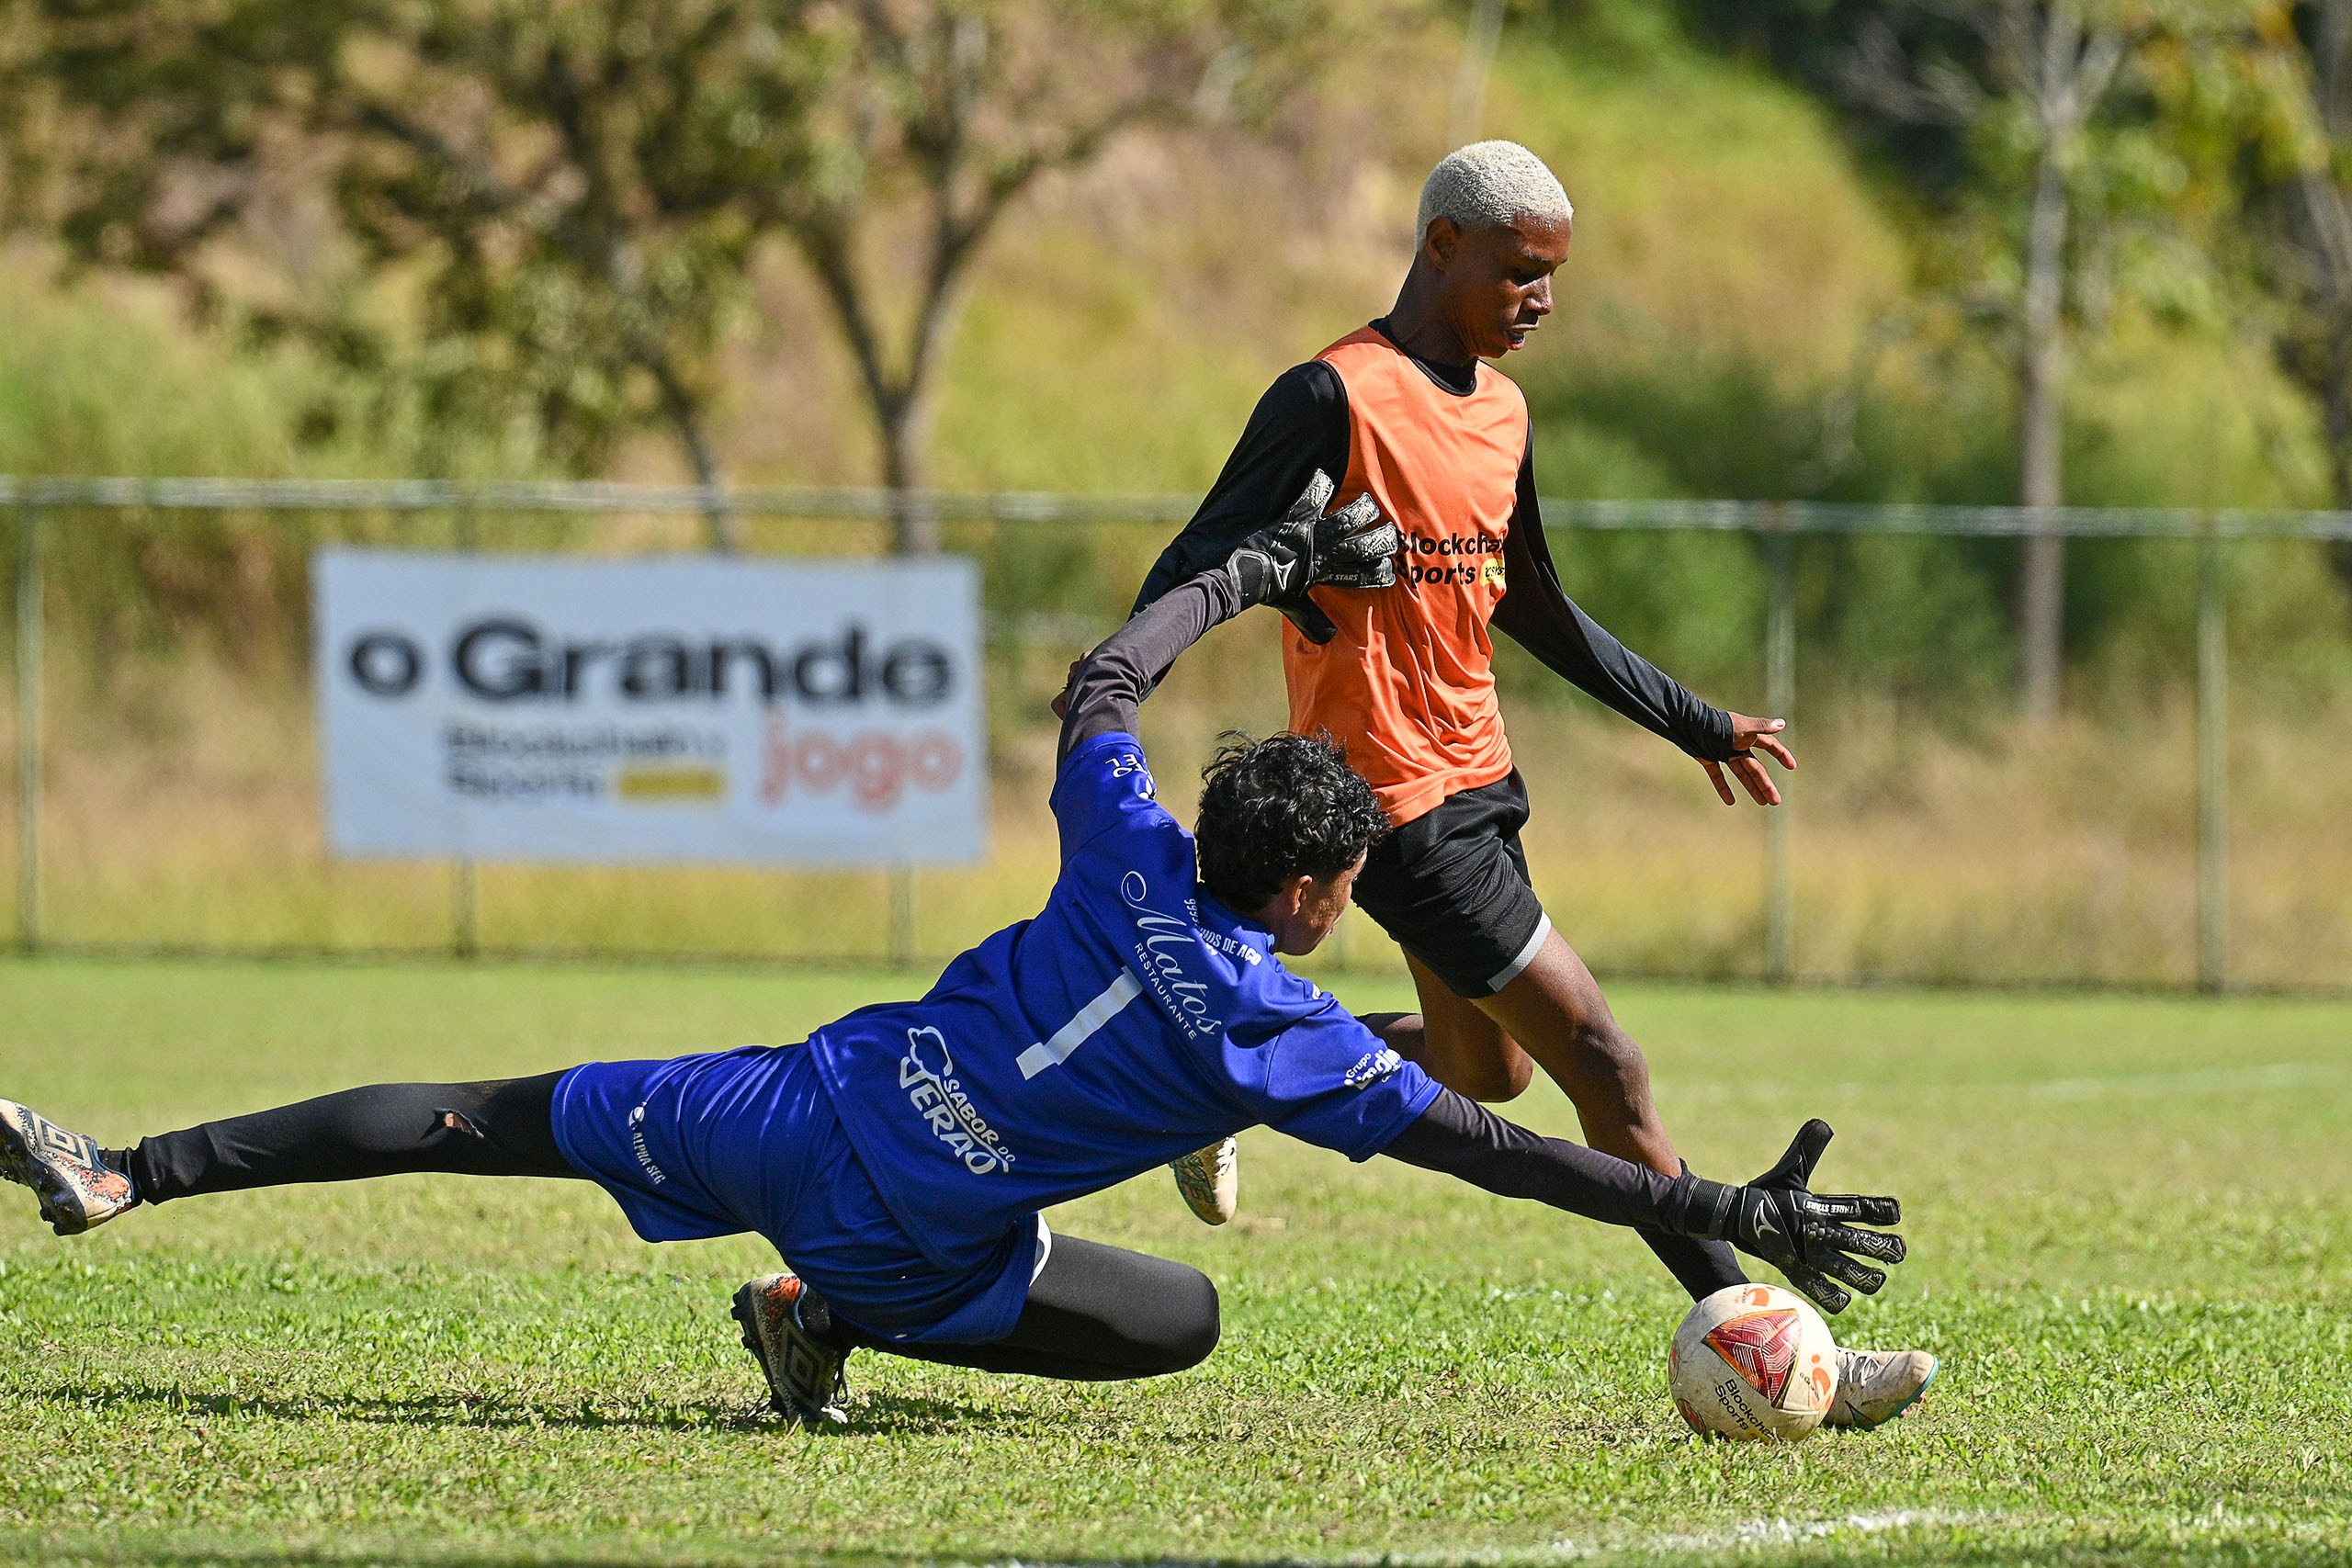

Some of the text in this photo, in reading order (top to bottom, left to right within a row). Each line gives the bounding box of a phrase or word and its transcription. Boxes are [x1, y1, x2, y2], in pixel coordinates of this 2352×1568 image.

[348, 613, 952, 710] o Grande
[759, 709, 963, 812] jogo
[1121, 870, 1223, 1035] Matos
[1222, 937, 1238, 954] DE
[1015, 965, 1144, 1081] 1
[1134, 942, 1197, 1041] RESTAURANTE
[1345, 1053, 1372, 1078] Grupo
[633, 1132, 666, 1185] ALPHA SEG
[943, 1077, 1016, 1164] SABOR DO
[1806, 1201, 1830, 1213] STARS
[1714, 1384, 1749, 1430] Sports
